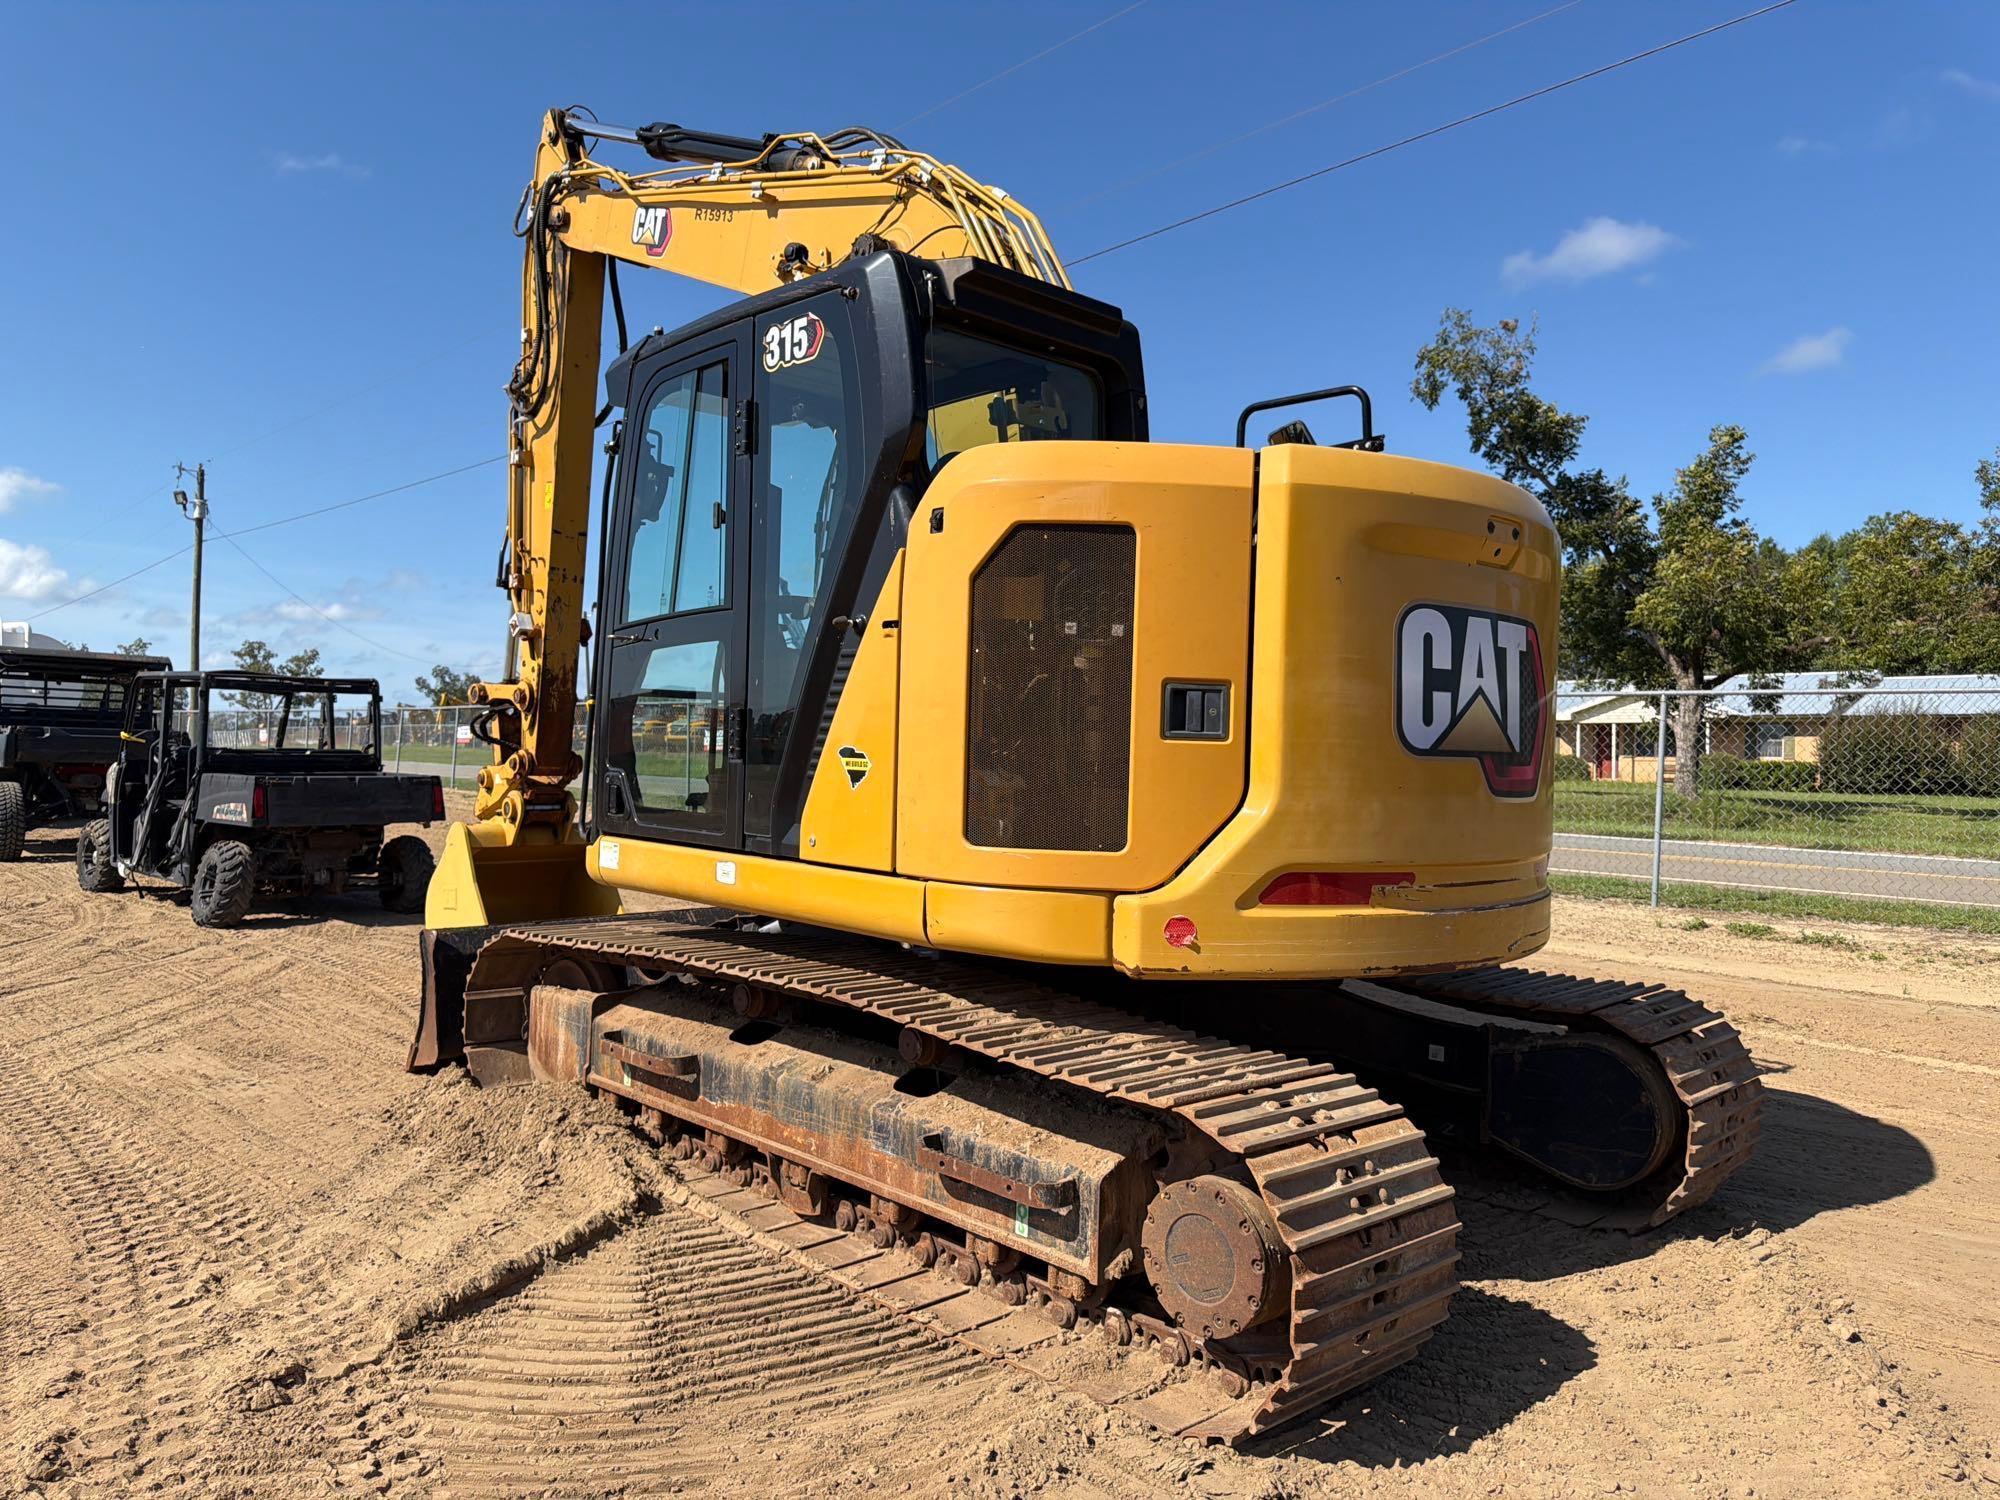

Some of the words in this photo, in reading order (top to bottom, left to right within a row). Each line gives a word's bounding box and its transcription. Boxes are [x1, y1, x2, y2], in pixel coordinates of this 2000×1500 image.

[633, 207, 667, 245] CAT
[694, 208, 734, 223] R15913
[765, 316, 809, 368] 315
[1401, 608, 1527, 753] CAT
